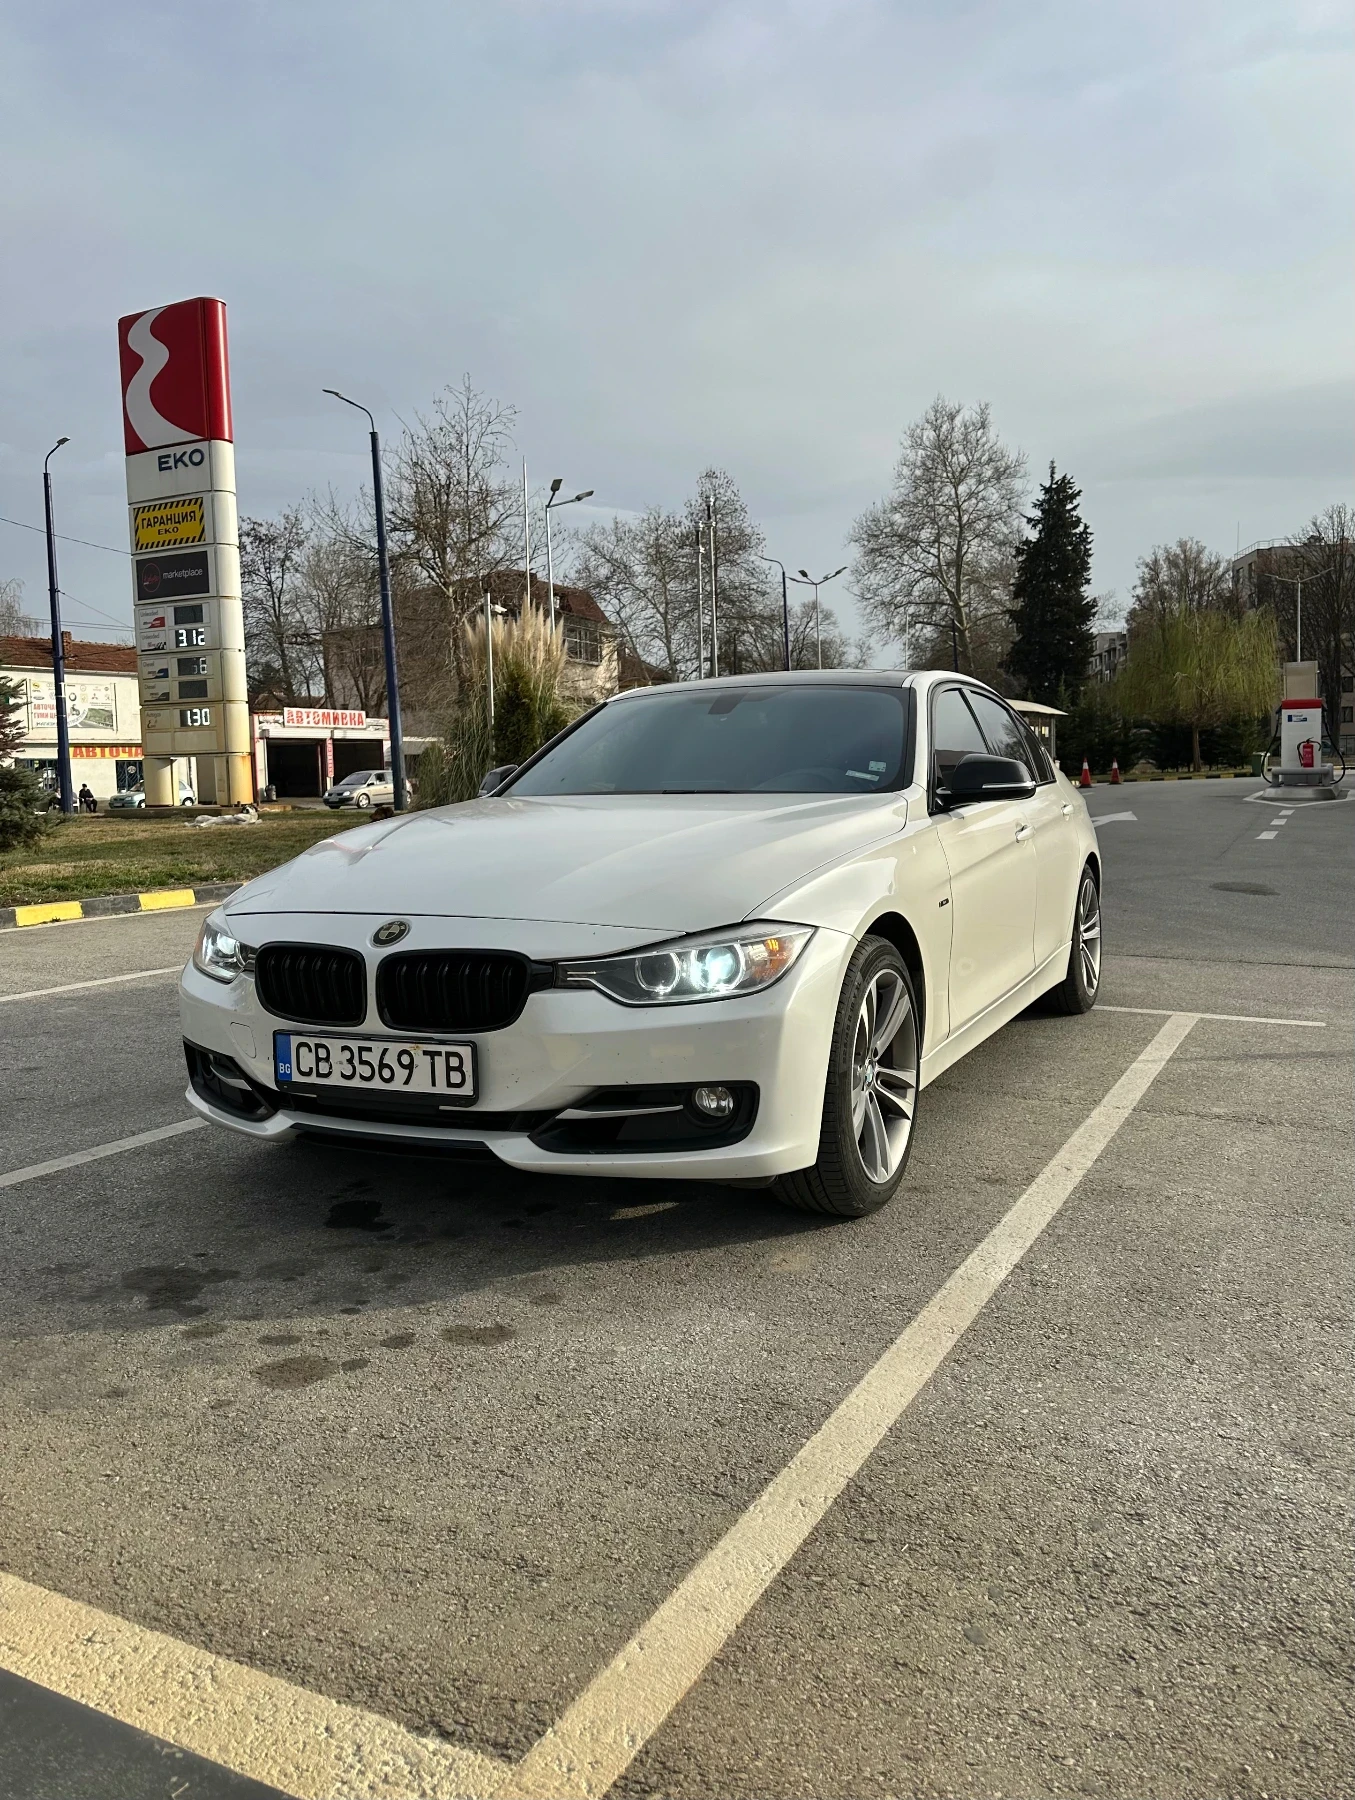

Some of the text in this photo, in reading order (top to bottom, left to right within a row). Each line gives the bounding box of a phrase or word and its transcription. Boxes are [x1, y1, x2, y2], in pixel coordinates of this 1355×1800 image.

[158, 448, 204, 472] EKO
[141, 510, 197, 529] ГАРАНЦИЯ
[162, 568, 203, 579] marketplace
[286, 709, 364, 726] АВТОМИВКА
[279, 1062, 291, 1074] BG
[295, 1041, 466, 1089] CB 3569 TB
